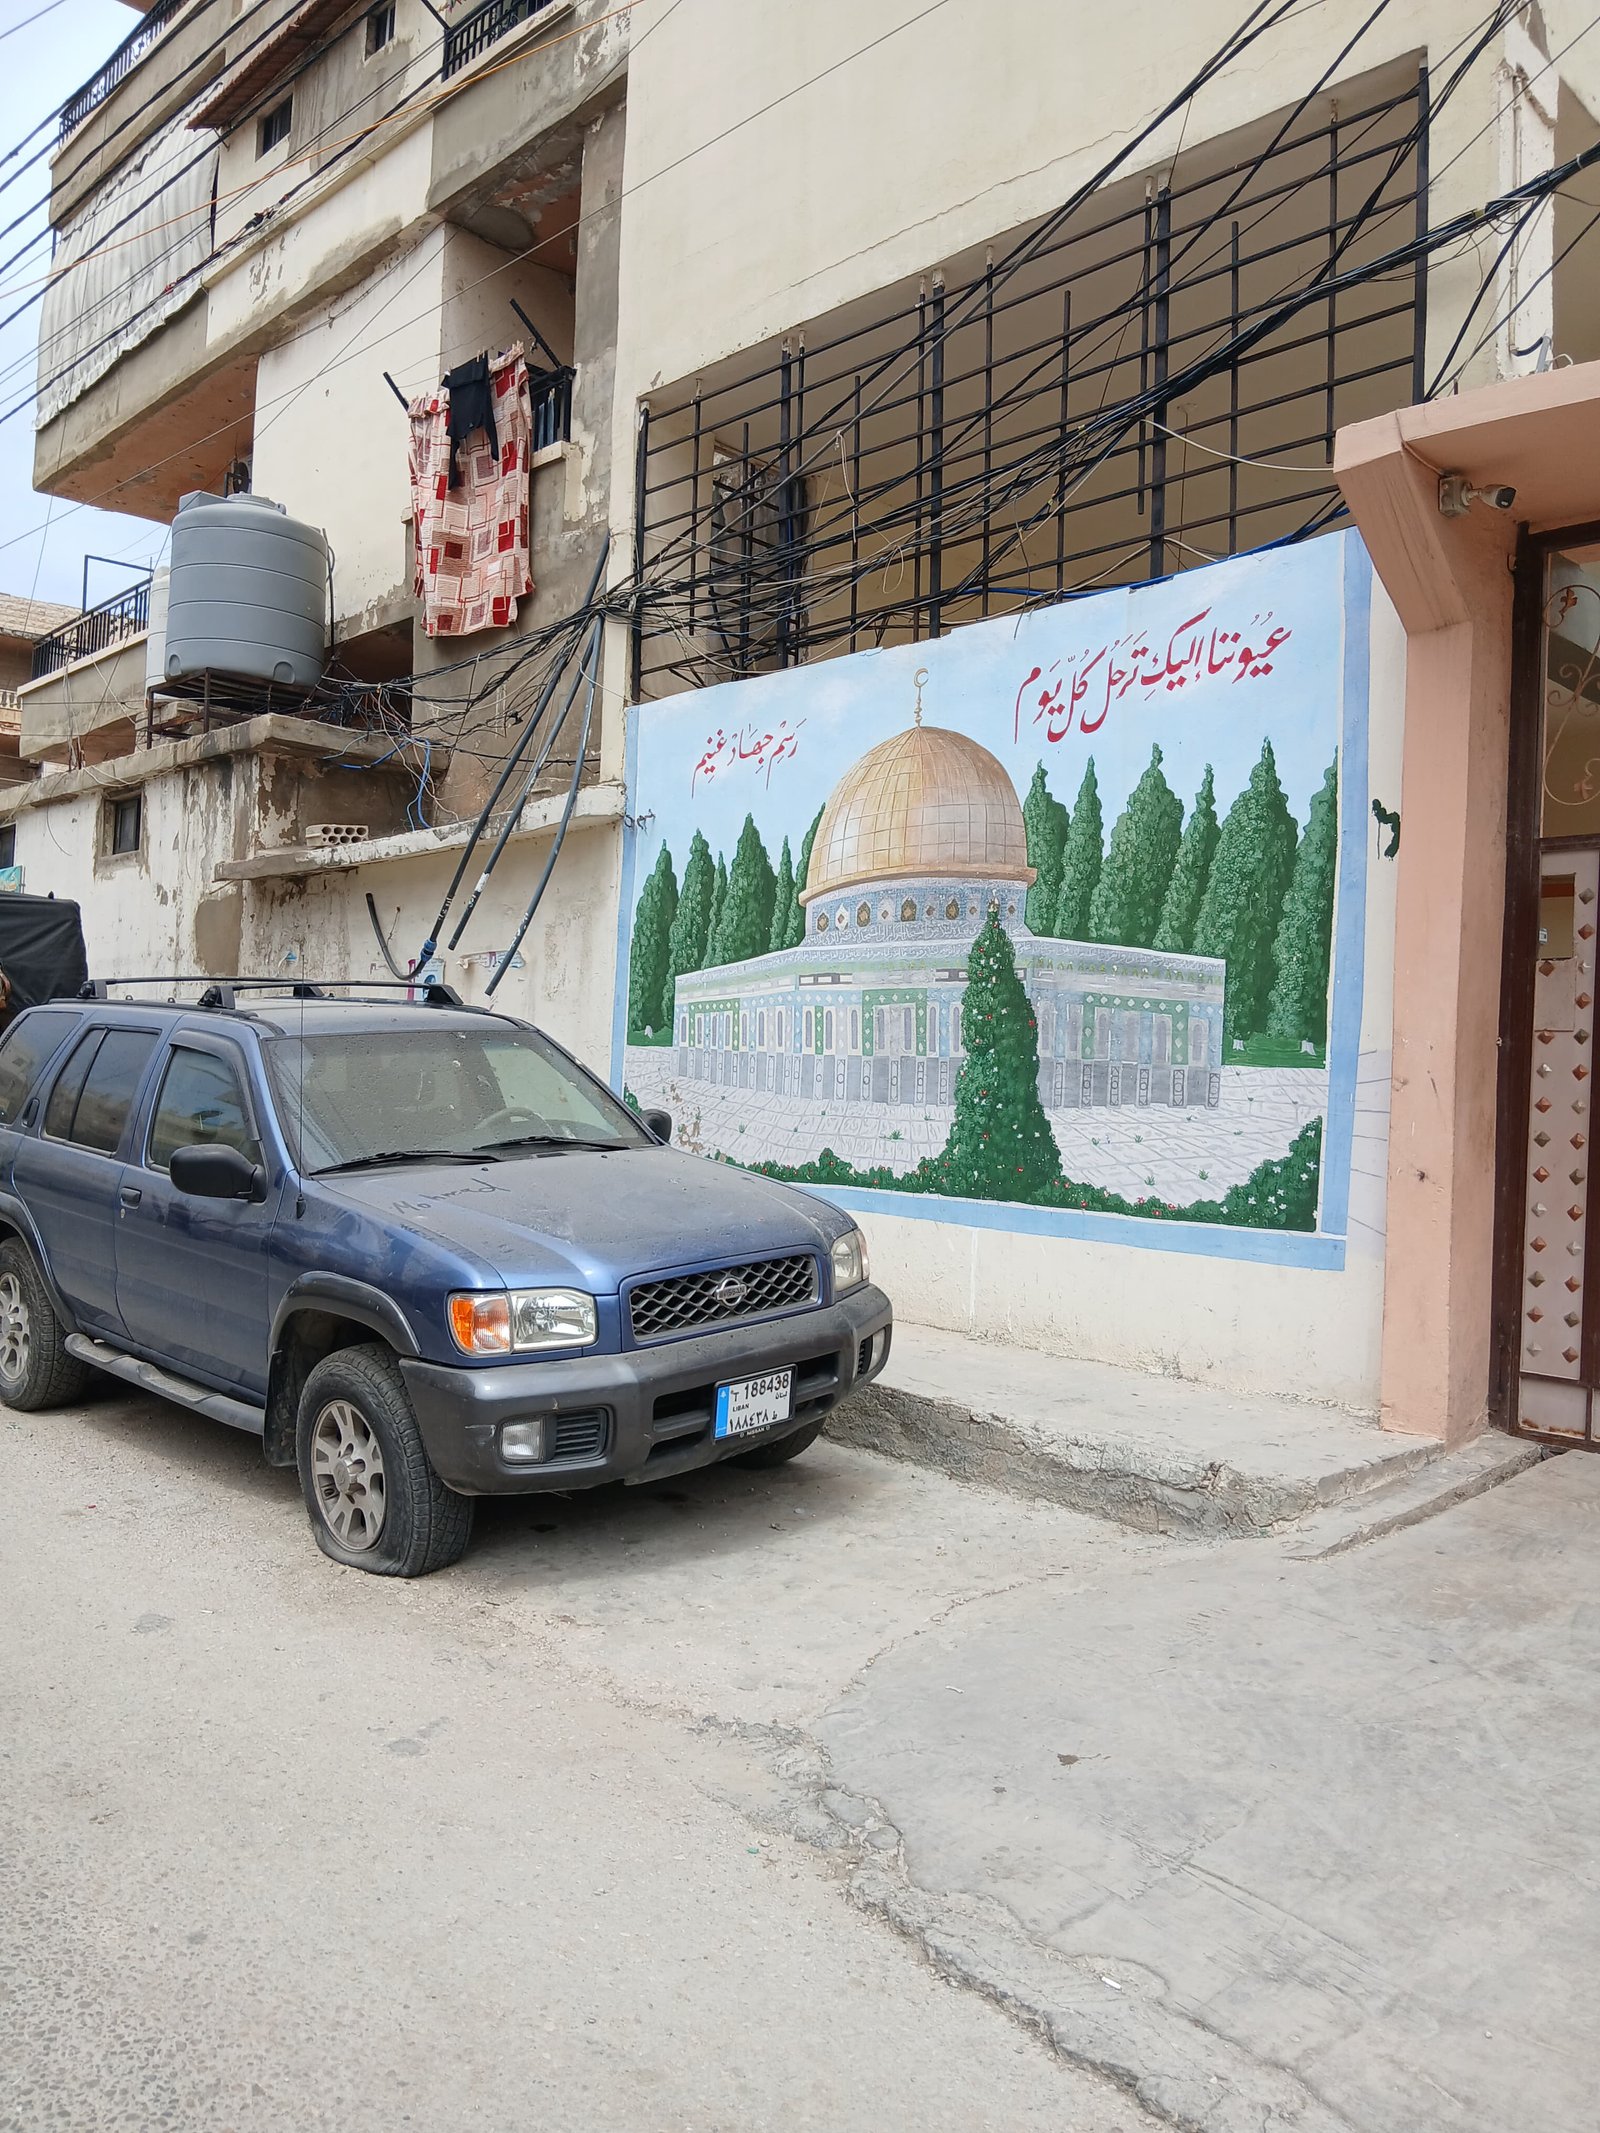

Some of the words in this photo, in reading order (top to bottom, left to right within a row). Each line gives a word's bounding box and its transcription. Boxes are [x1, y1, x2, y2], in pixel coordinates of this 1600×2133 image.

[744, 1373, 789, 1400] 188438
[732, 1403, 750, 1412] LIBAN
[729, 1408, 769, 1432] ١٨٨٤٣٨
